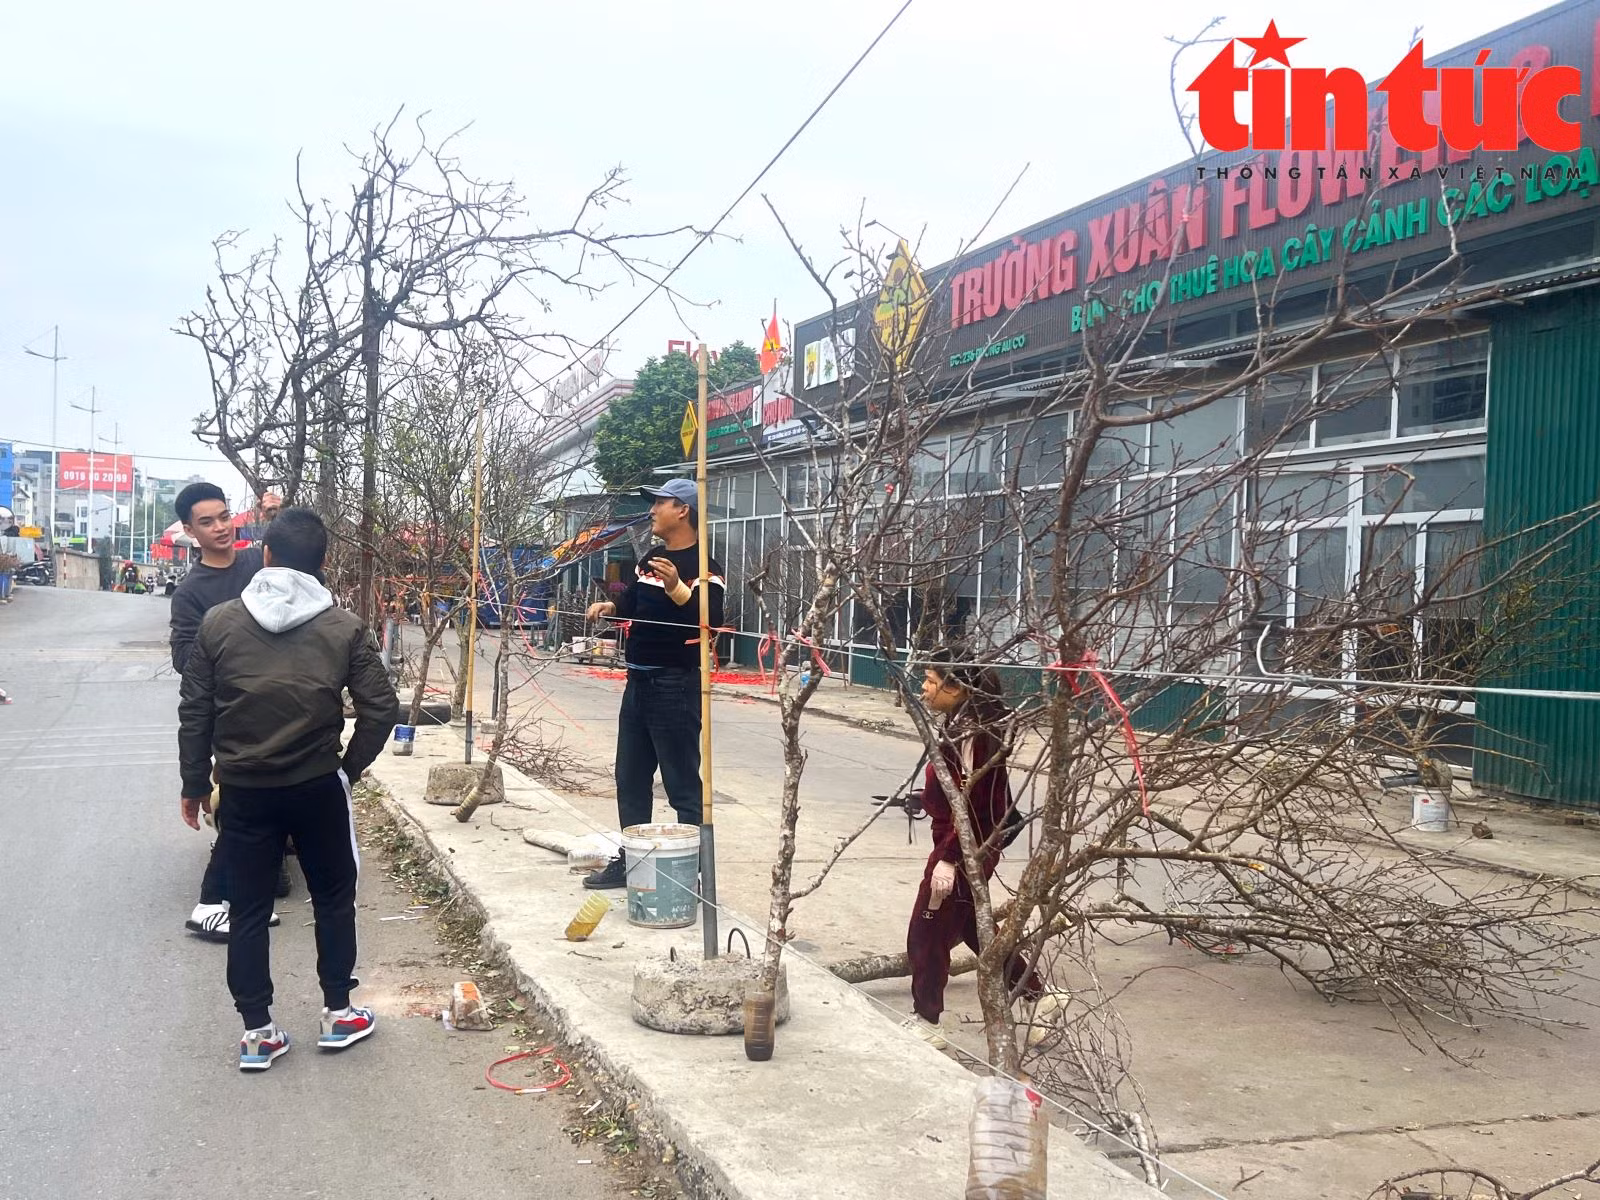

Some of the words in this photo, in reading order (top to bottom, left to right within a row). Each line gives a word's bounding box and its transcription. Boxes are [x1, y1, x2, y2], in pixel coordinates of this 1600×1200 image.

[950, 230, 1077, 328] TRƯỜNG
[1084, 178, 1209, 284] XUÂN
[1169, 255, 1219, 305] THUÊ
[1223, 246, 1276, 289] HOA
[1282, 223, 1335, 272] CÂY
[1342, 199, 1429, 254] CẢNH
[1437, 171, 1515, 226] CÁC
[102, 472, 113, 482] 20
